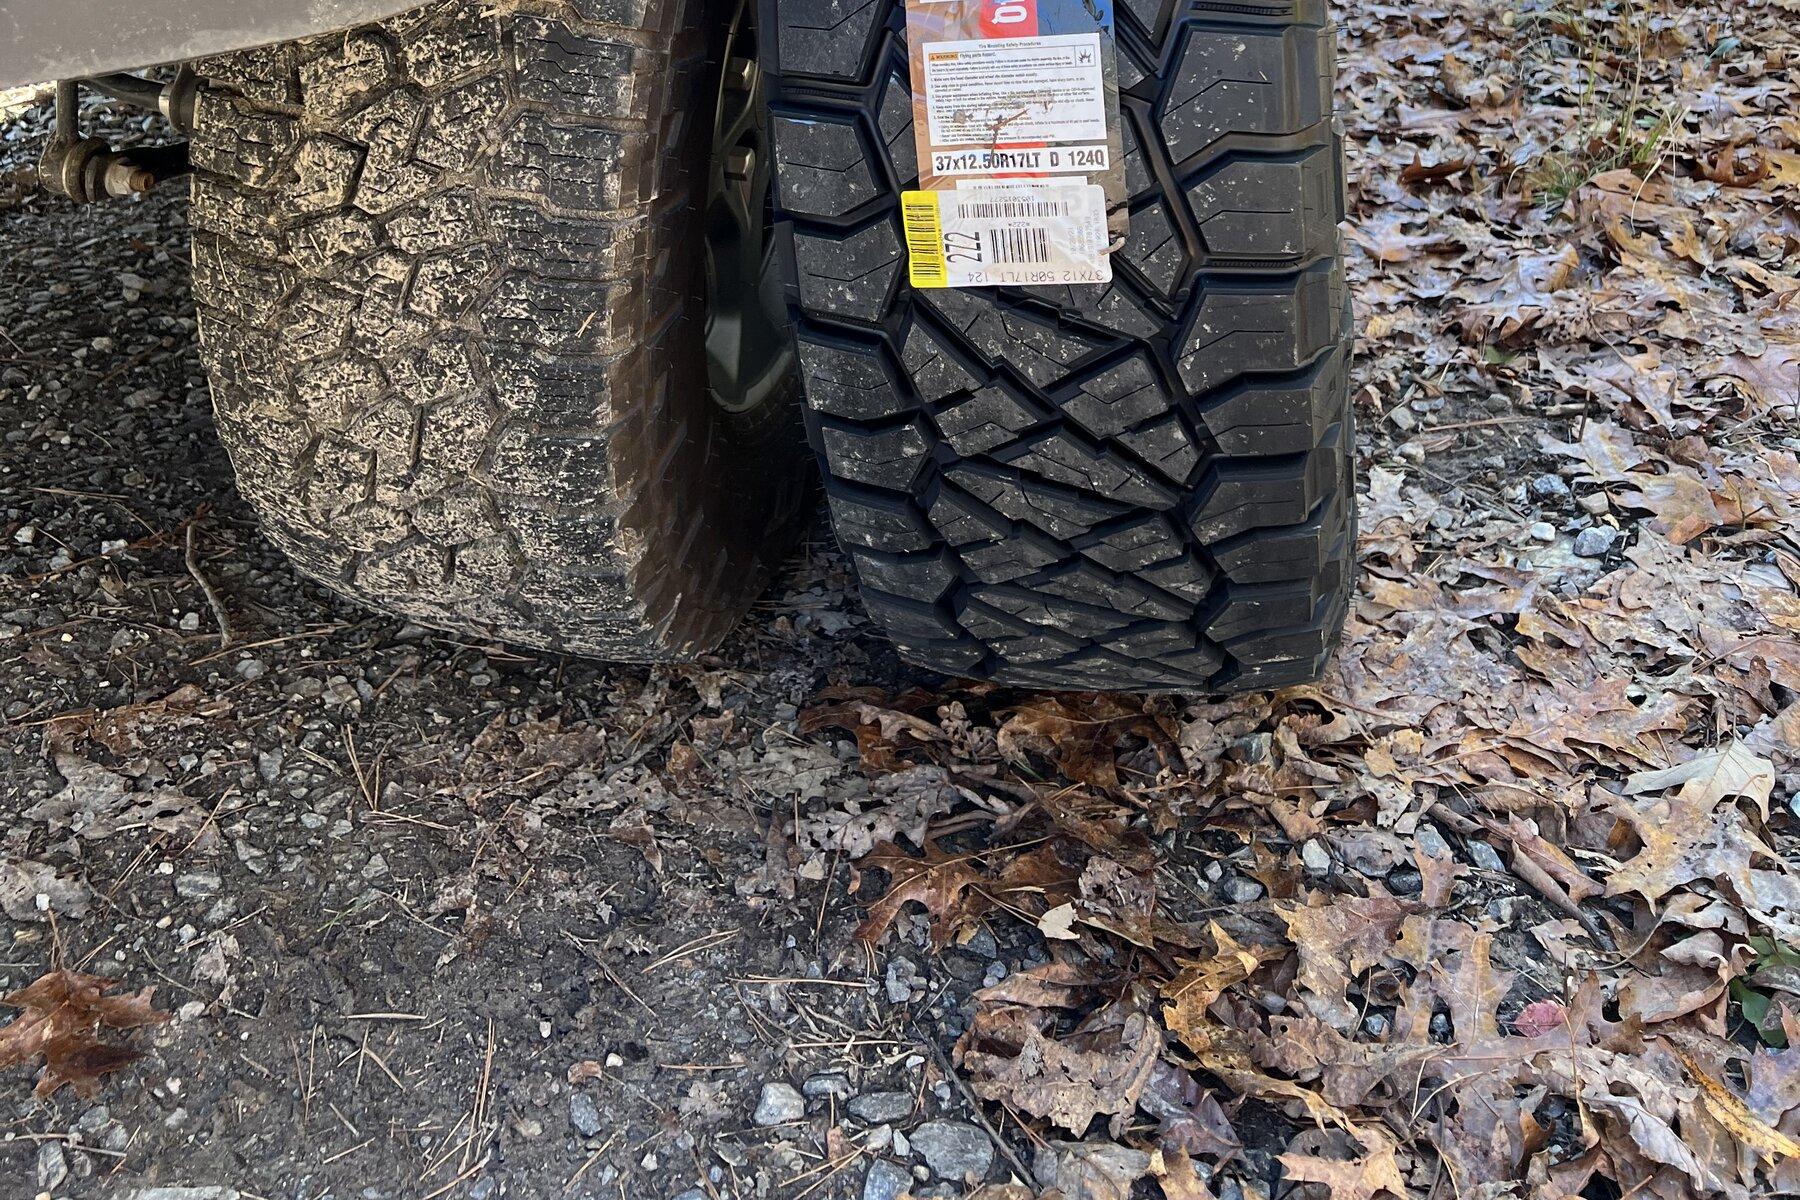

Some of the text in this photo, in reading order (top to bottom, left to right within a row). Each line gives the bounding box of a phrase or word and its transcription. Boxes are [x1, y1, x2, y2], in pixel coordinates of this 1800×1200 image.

[936, 149, 1106, 172] 37x12.50R17LT D 124Q
[967, 271, 989, 283] 124
